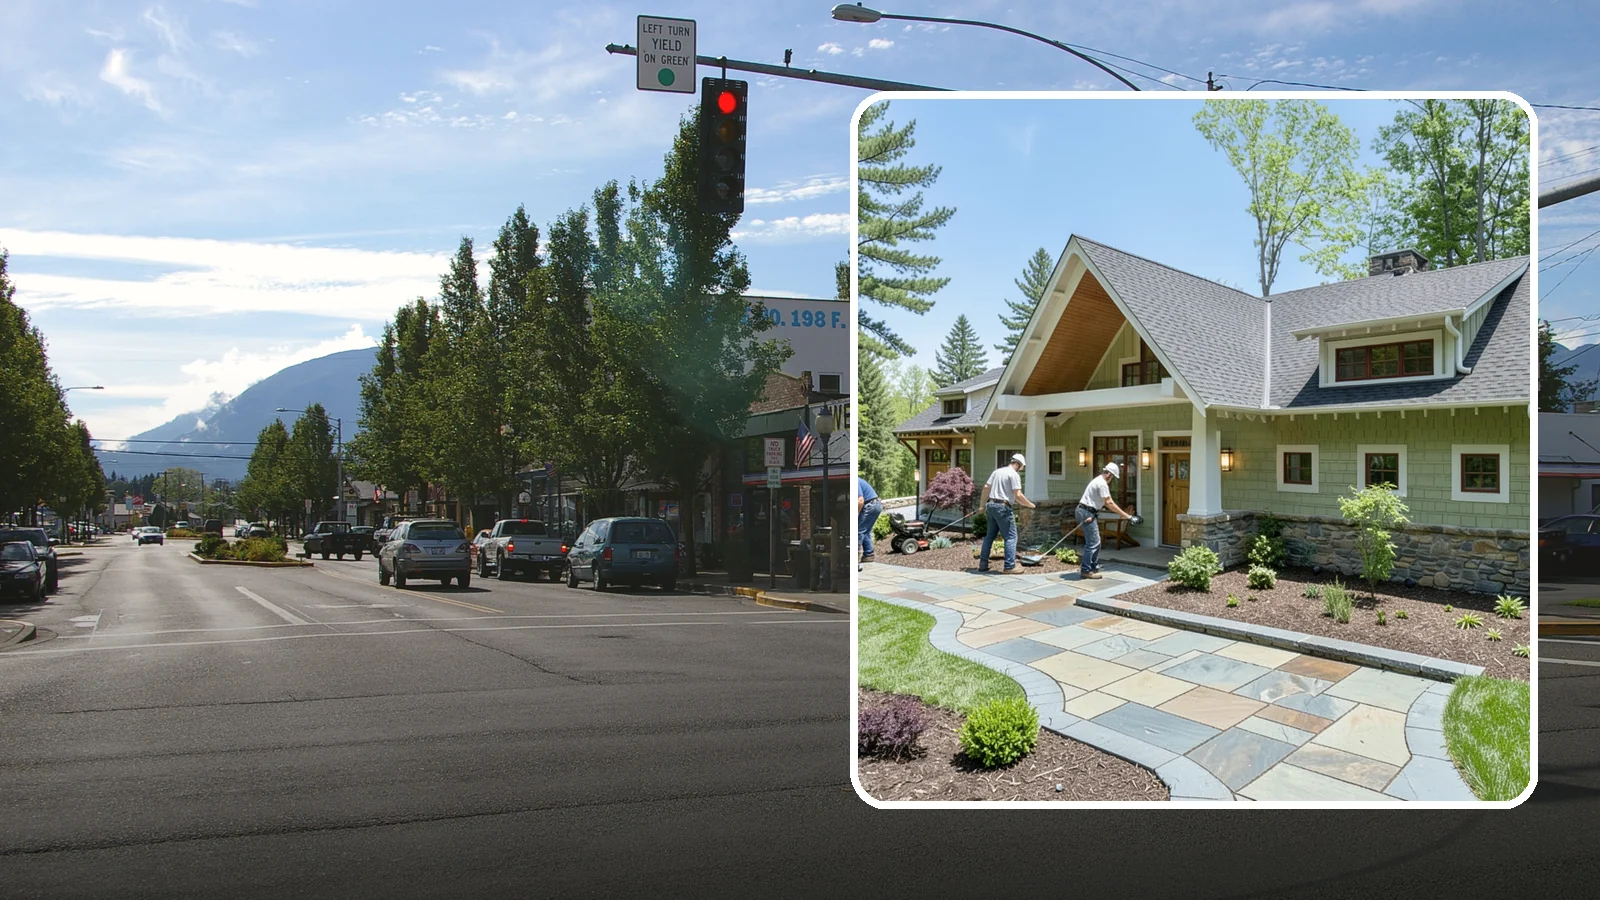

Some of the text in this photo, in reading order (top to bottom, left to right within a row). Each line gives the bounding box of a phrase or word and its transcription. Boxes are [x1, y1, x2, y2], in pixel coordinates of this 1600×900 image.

[643, 23, 690, 36] LEFT TURN
[652, 38, 682, 51] YIELD
[644, 53, 688, 66] ON GREEN
[791, 309, 826, 328] 198
[831, 311, 847, 329] F.
